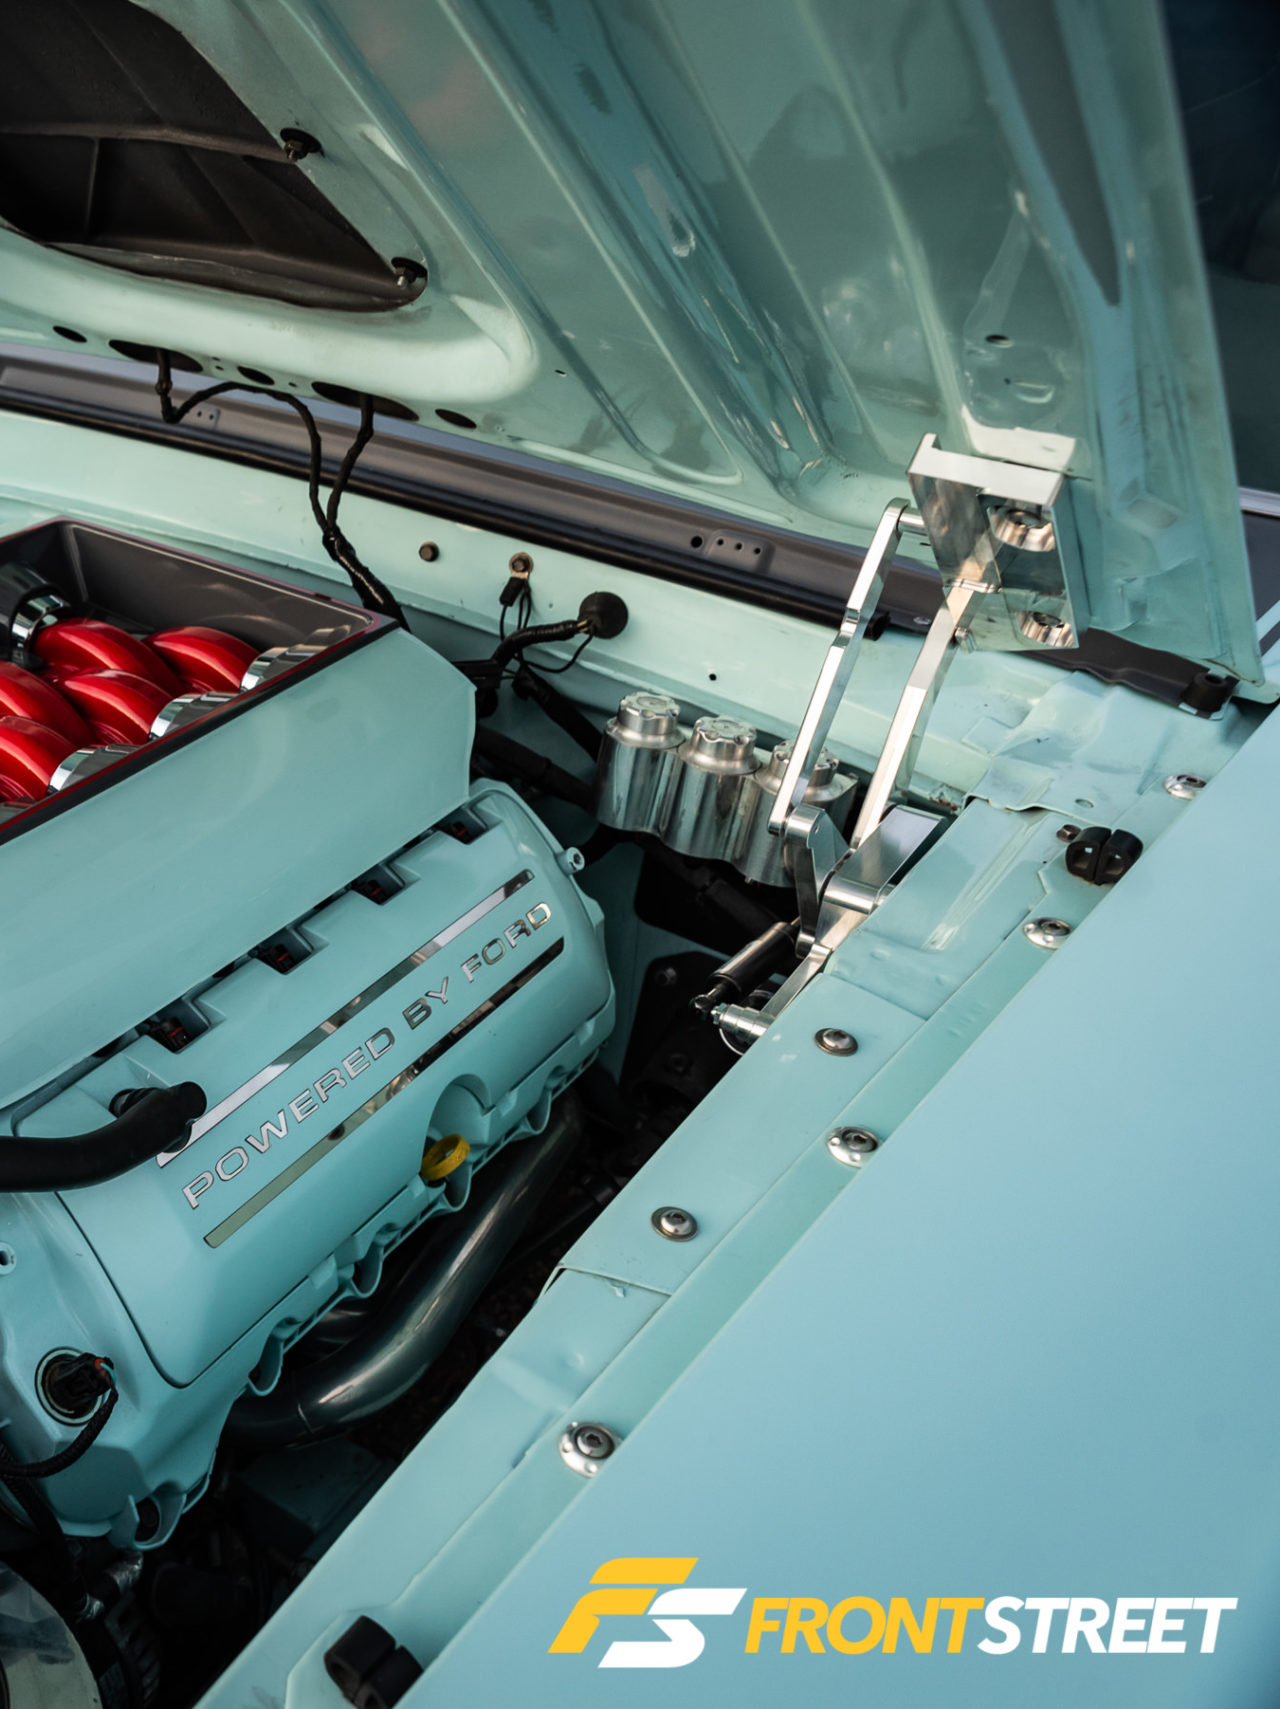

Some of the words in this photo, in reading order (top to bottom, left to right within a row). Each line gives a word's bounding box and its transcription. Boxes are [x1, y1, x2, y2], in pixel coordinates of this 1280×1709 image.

[182, 1027, 396, 1210] POWERED
[402, 976, 450, 1031] BY
[461, 901, 552, 983] FORD
